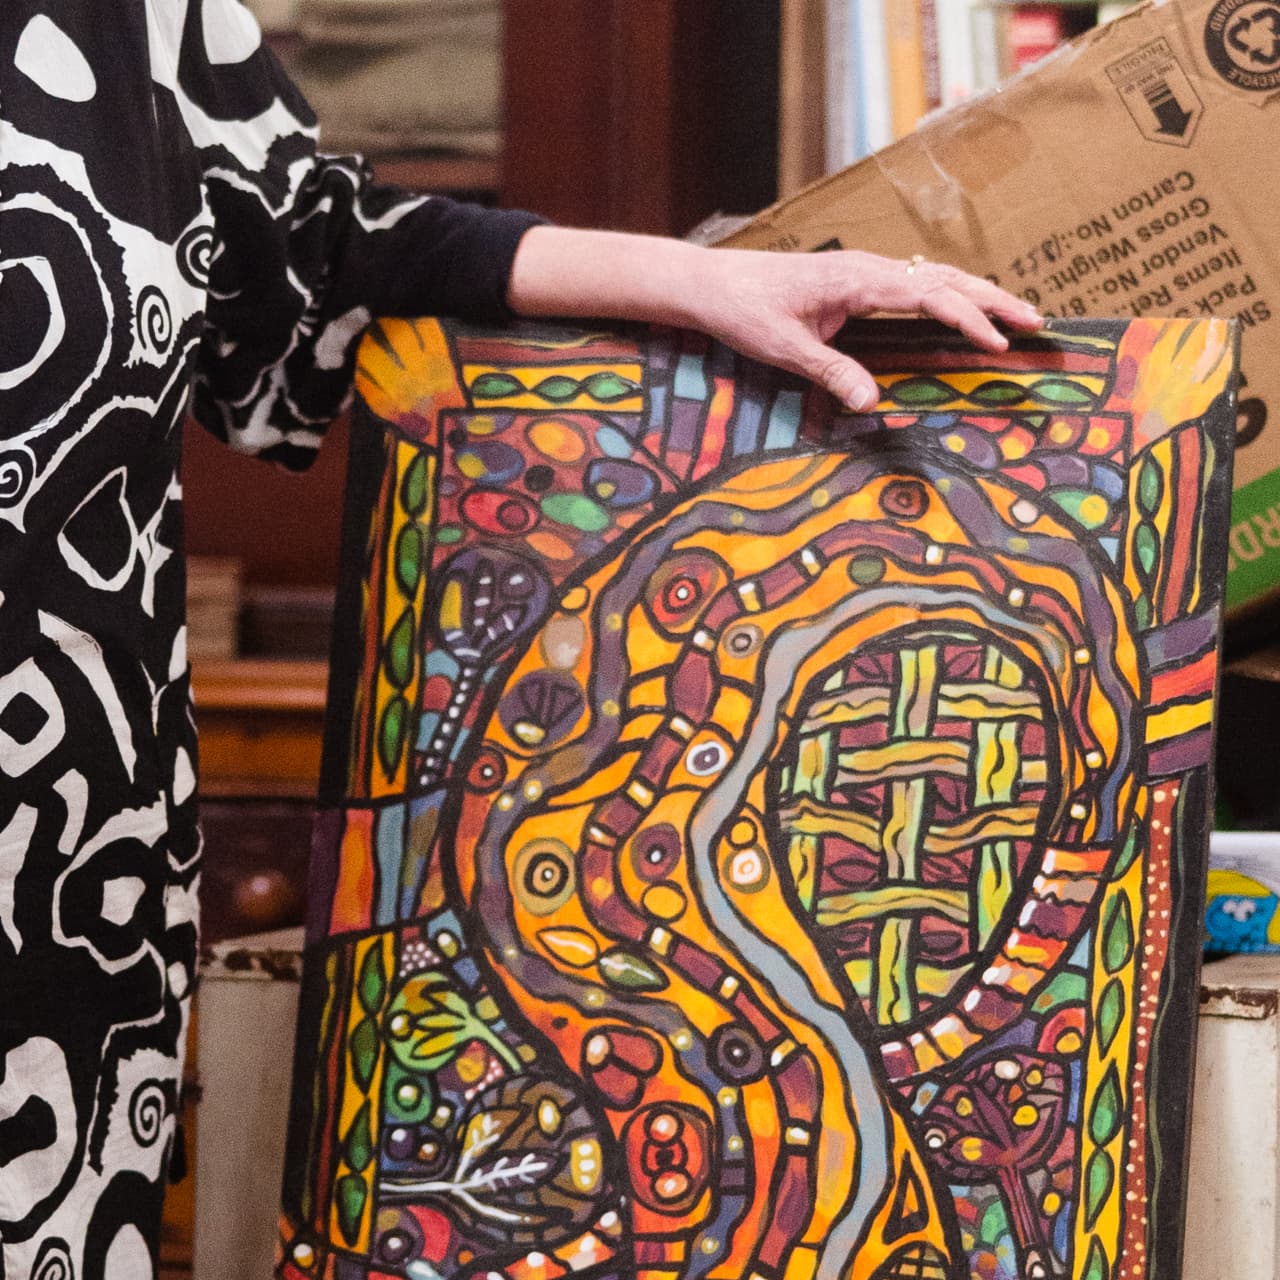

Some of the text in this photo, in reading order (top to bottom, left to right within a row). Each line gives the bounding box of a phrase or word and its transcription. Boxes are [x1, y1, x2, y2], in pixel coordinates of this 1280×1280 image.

[1113, 171, 1195, 220] Carton
[1062, 215, 1112, 248] No.:
[1137, 197, 1210, 241] Gross
[1050, 238, 1136, 290] Weight:
[1142, 224, 1228, 275] Vendor
[1173, 249, 1242, 290] Items
[1088, 269, 1139, 302] No.:
[1195, 275, 1256, 313] Pack
[1230, 510, 1280, 569] RD
